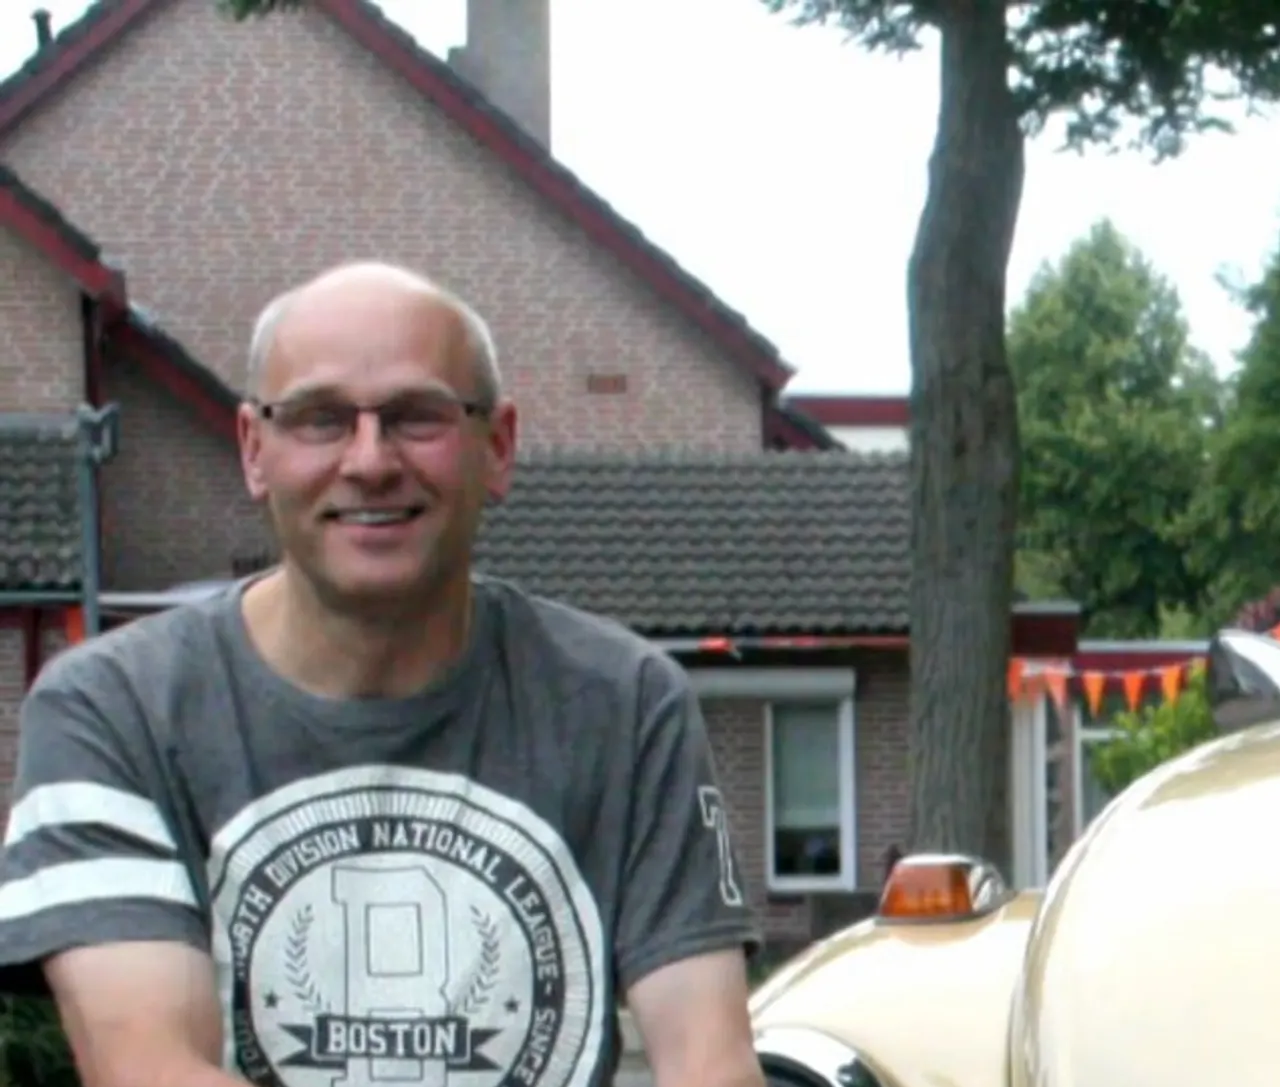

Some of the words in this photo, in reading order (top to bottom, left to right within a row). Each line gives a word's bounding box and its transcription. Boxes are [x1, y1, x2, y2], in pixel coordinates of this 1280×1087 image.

[263, 823, 361, 889] DIVISION
[371, 820, 501, 884] NATIONAL
[327, 1020, 458, 1056] BOSTON
[514, 1007, 557, 1086] SINCE
